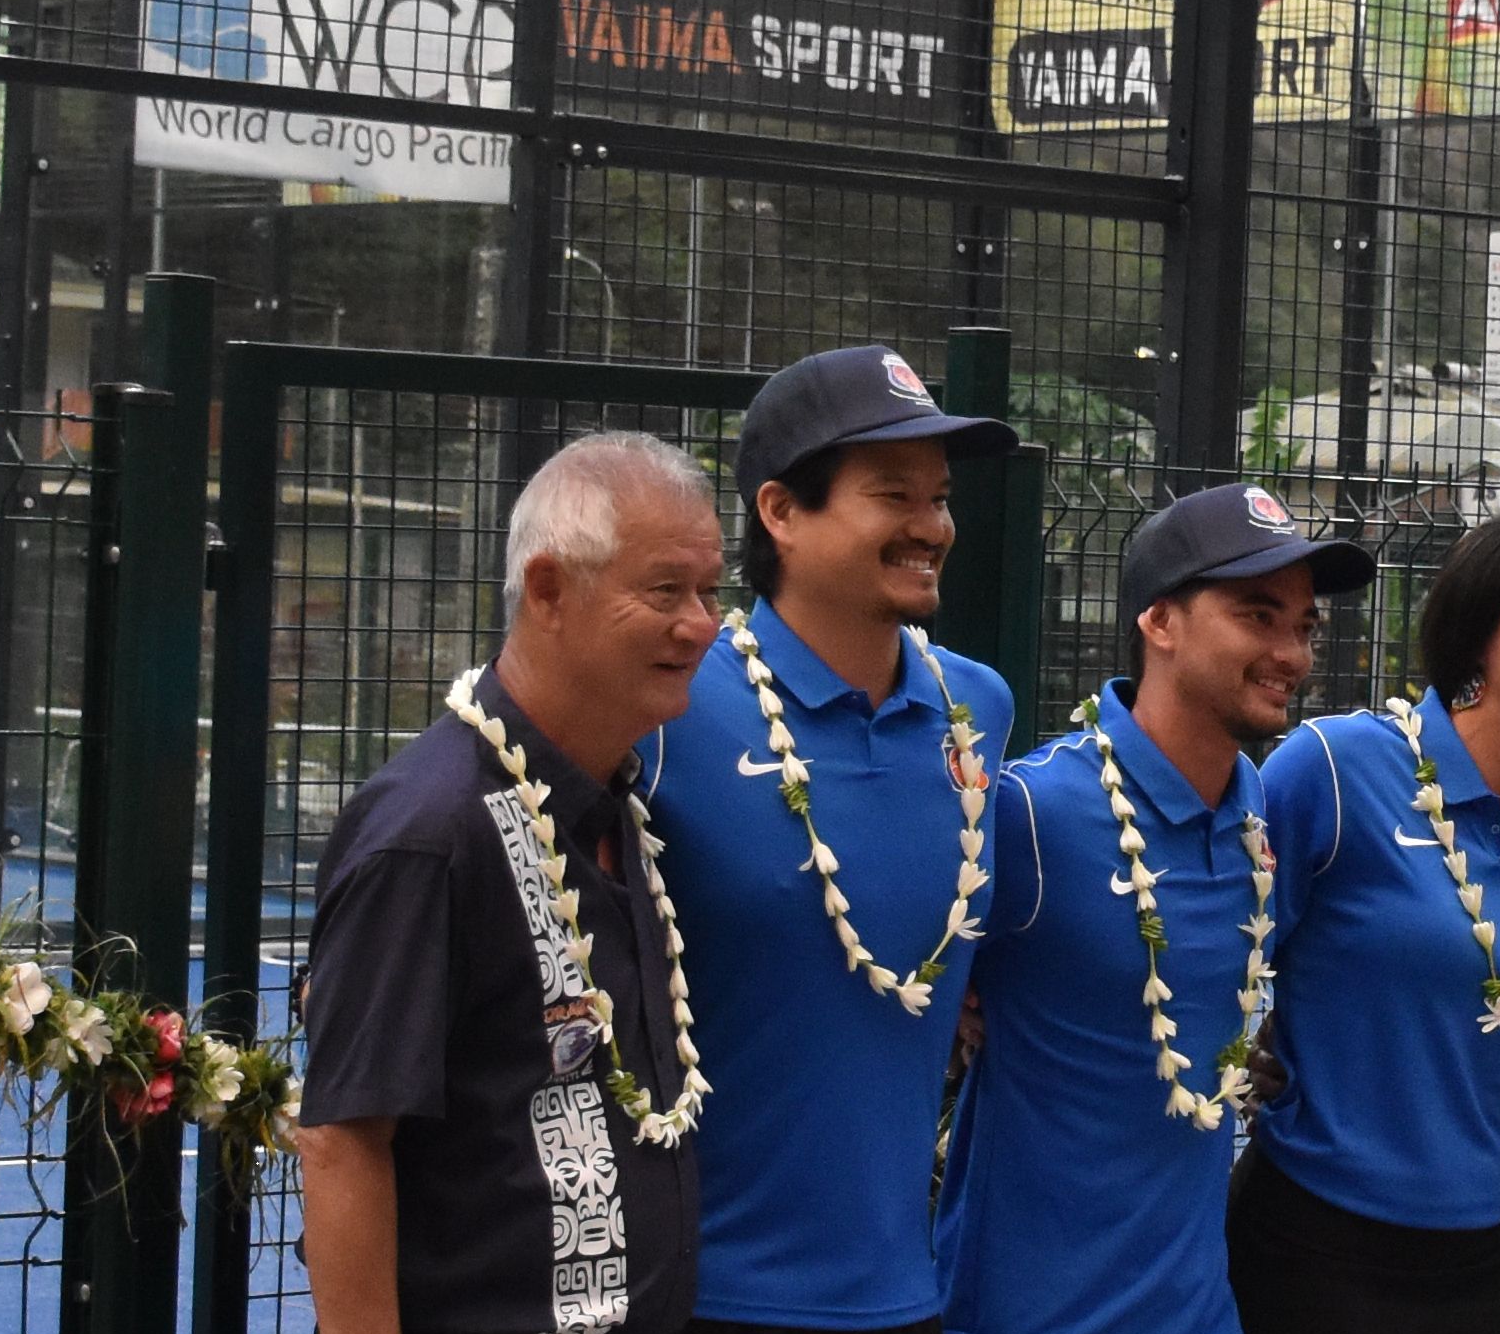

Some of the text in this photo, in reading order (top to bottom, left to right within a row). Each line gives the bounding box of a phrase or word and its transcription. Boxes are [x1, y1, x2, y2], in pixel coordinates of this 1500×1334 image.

[751, 13, 945, 99] SPORT
[1018, 44, 1159, 109] VAIMA
[150, 97, 510, 167] World Cargo Pacifi
